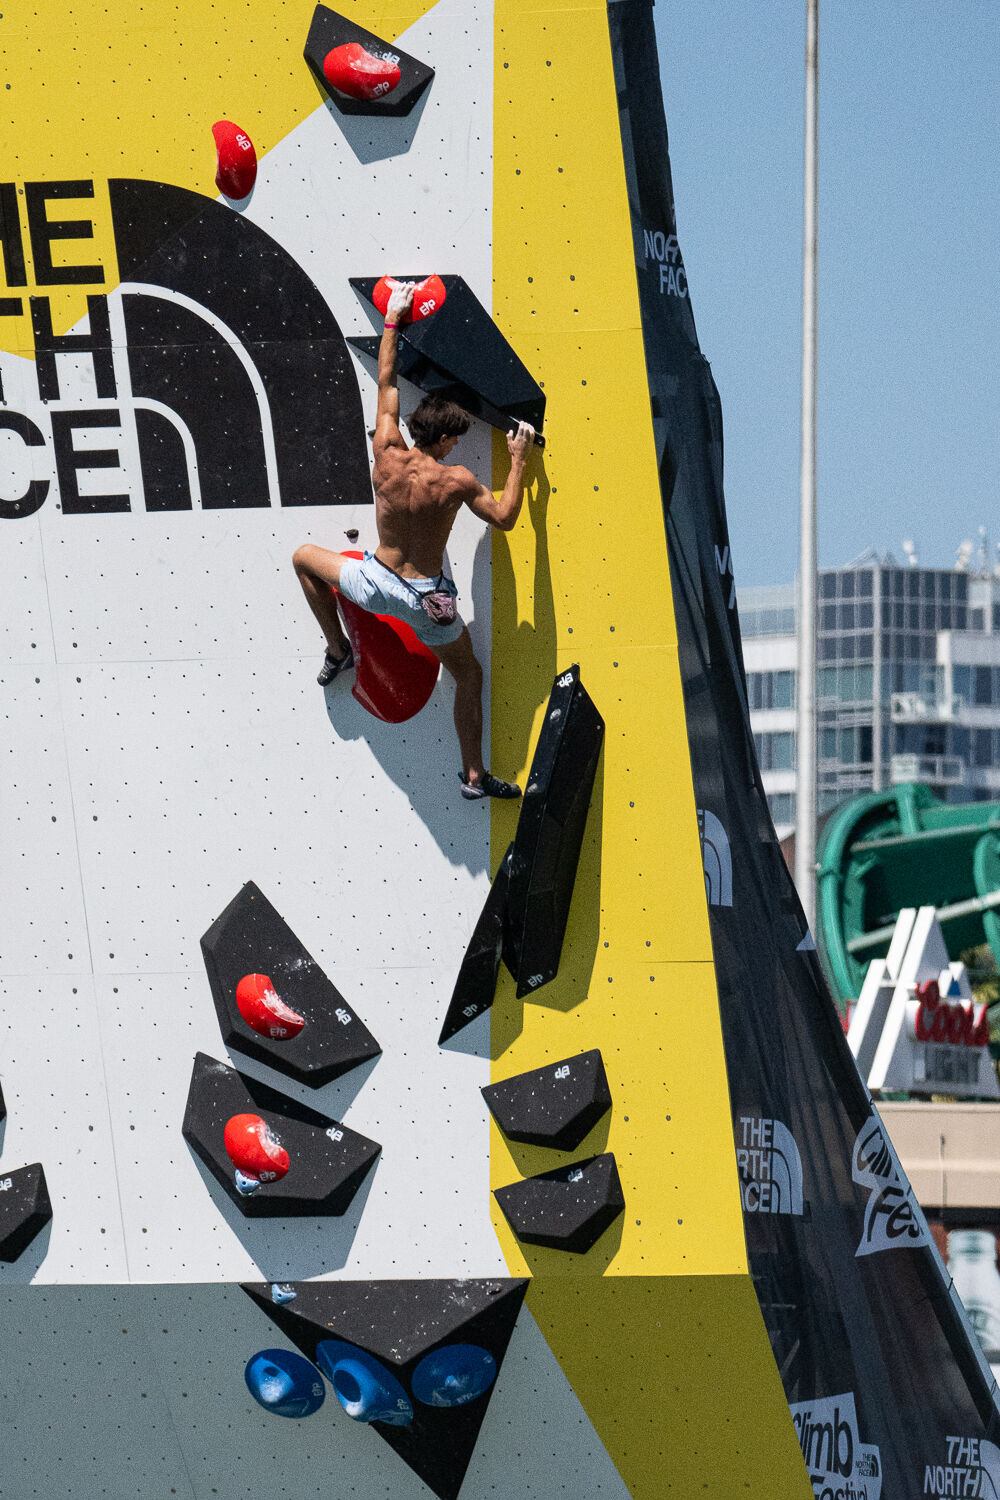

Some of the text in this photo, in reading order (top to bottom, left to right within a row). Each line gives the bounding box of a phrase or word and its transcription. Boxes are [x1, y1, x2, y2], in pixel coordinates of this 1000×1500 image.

[659, 263, 688, 298] FAC
[740, 1117, 772, 1147] THE
[737, 1149, 771, 1180] RTH
[946, 1435, 980, 1466] THE
[923, 1465, 980, 1497] NORTH
